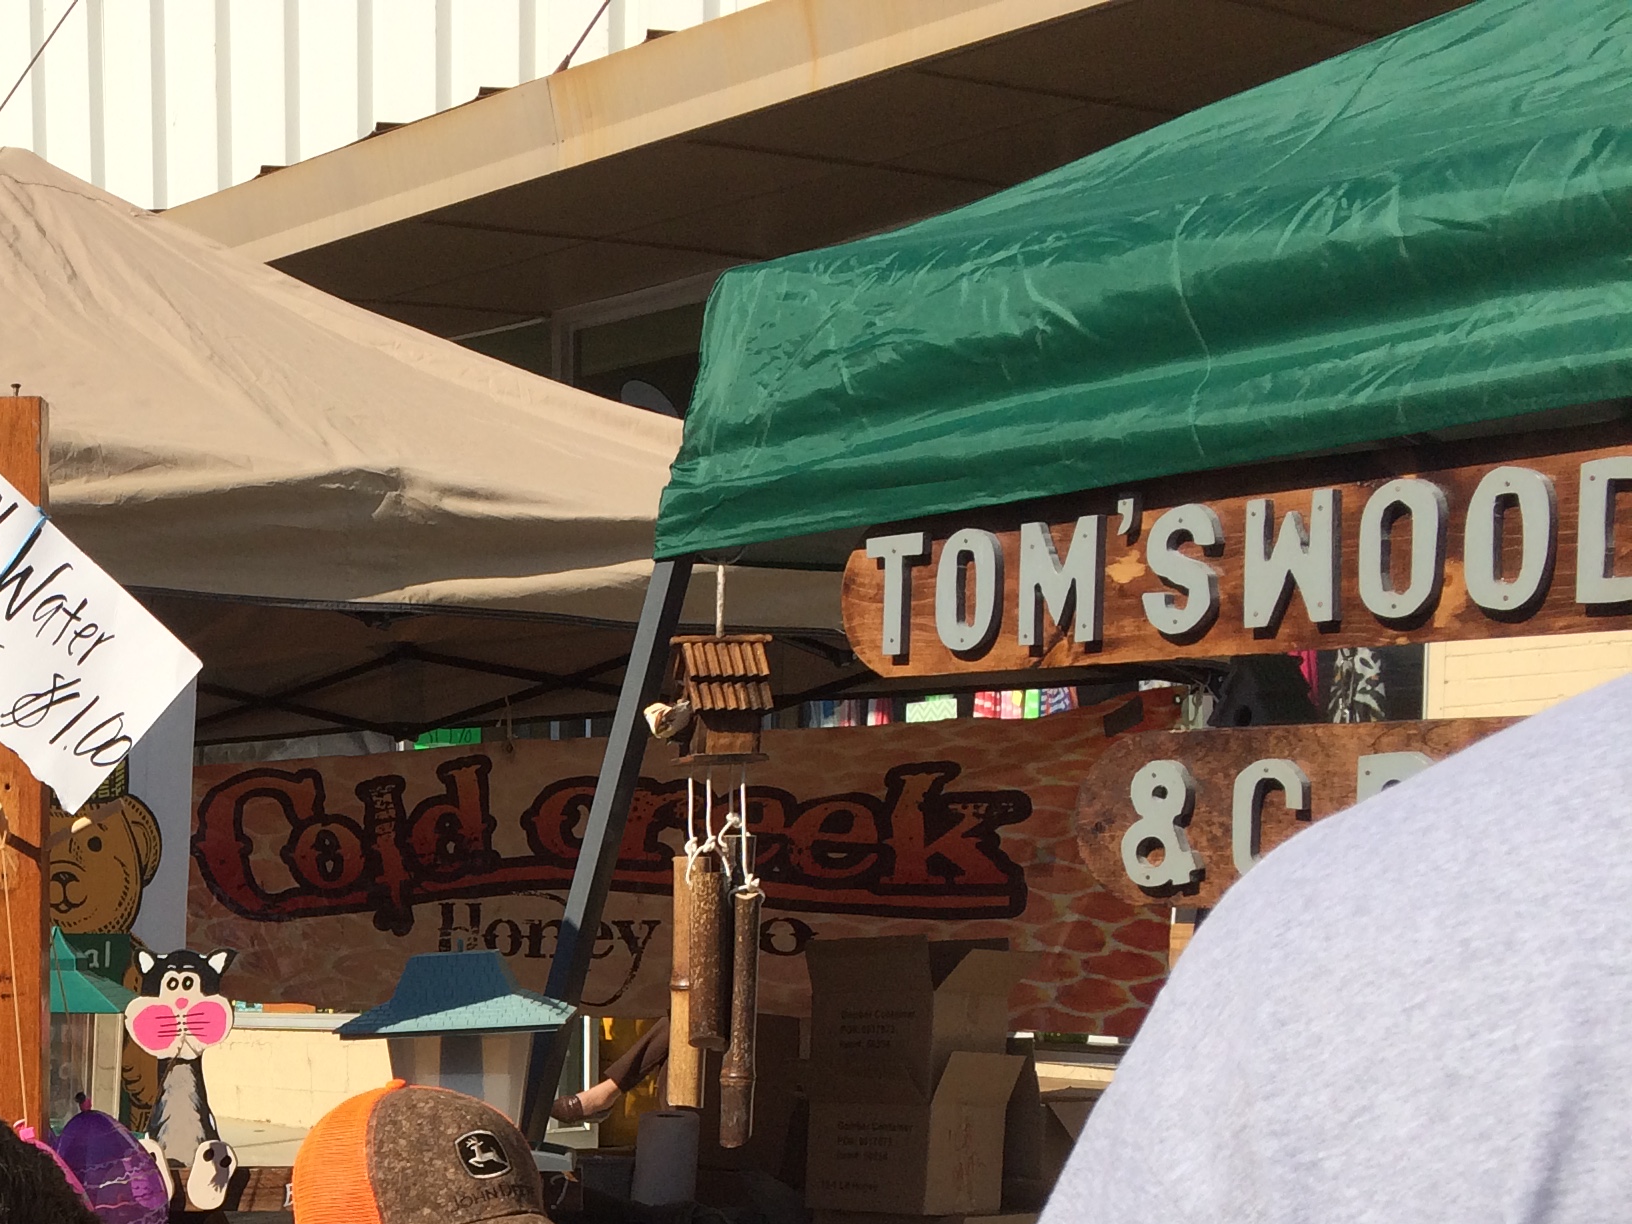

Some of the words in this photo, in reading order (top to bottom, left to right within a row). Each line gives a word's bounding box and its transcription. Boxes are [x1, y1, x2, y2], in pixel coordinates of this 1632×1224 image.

[0, 672, 134, 768] $1.00
[190, 754, 498, 936] Cold
[1121, 759, 1205, 892] &
[438, 892, 661, 1006] Honey
[450, 1186, 499, 1213] JOHN
